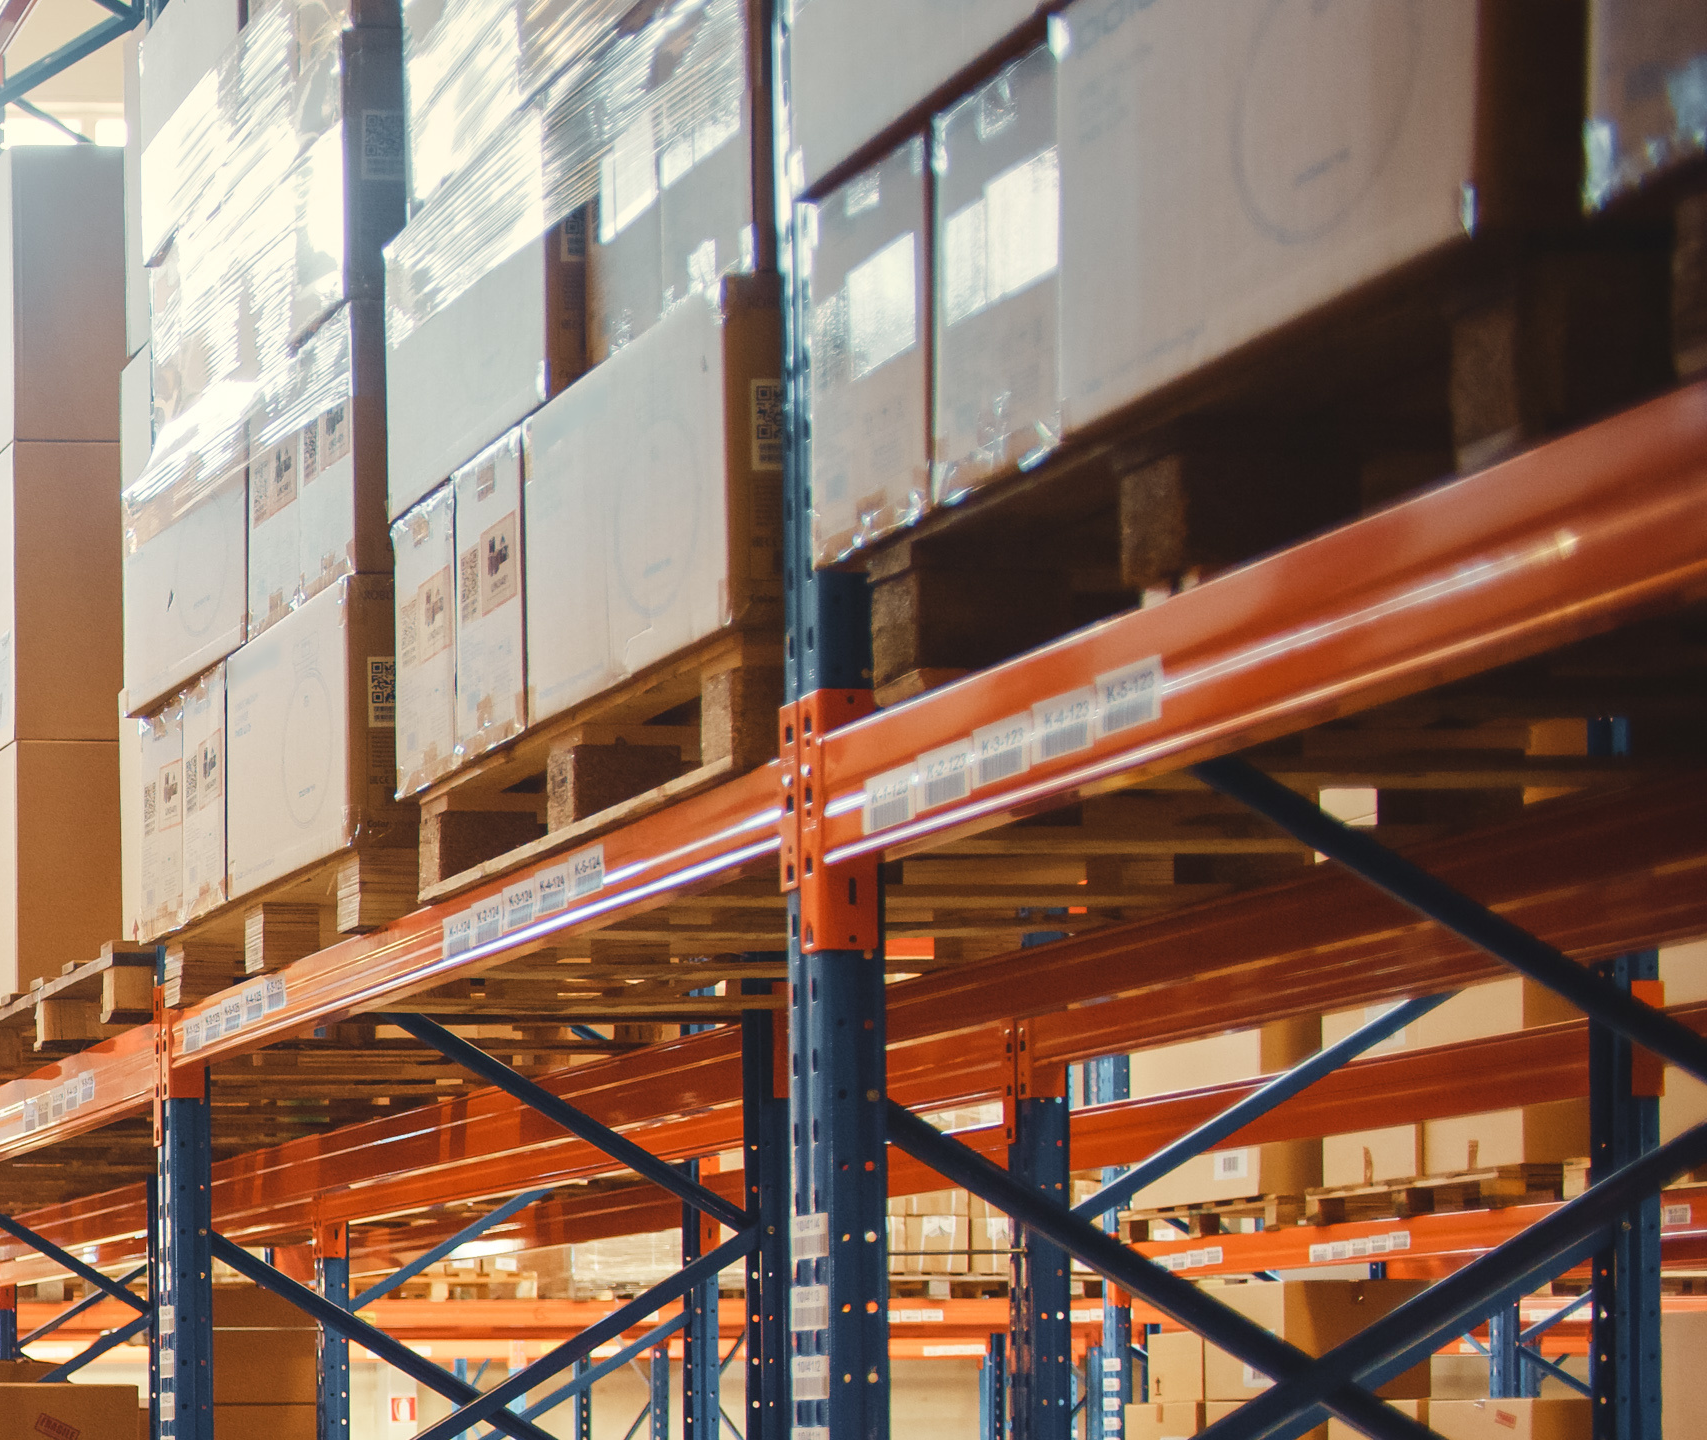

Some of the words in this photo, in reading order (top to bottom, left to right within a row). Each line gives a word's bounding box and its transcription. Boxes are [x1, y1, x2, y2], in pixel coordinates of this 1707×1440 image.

[1106, 671, 1155, 703] K-5-123
[1044, 701, 1089, 728] K-4-123
[981, 728, 1024, 754] K-3-123
[926, 753, 966, 780] K-2-123
[871, 780, 909, 804] K-1-123
[574, 855, 602, 875] K-5-124
[539, 875, 565, 892] K-4-124
[508, 889, 533, 906] K-3-124
